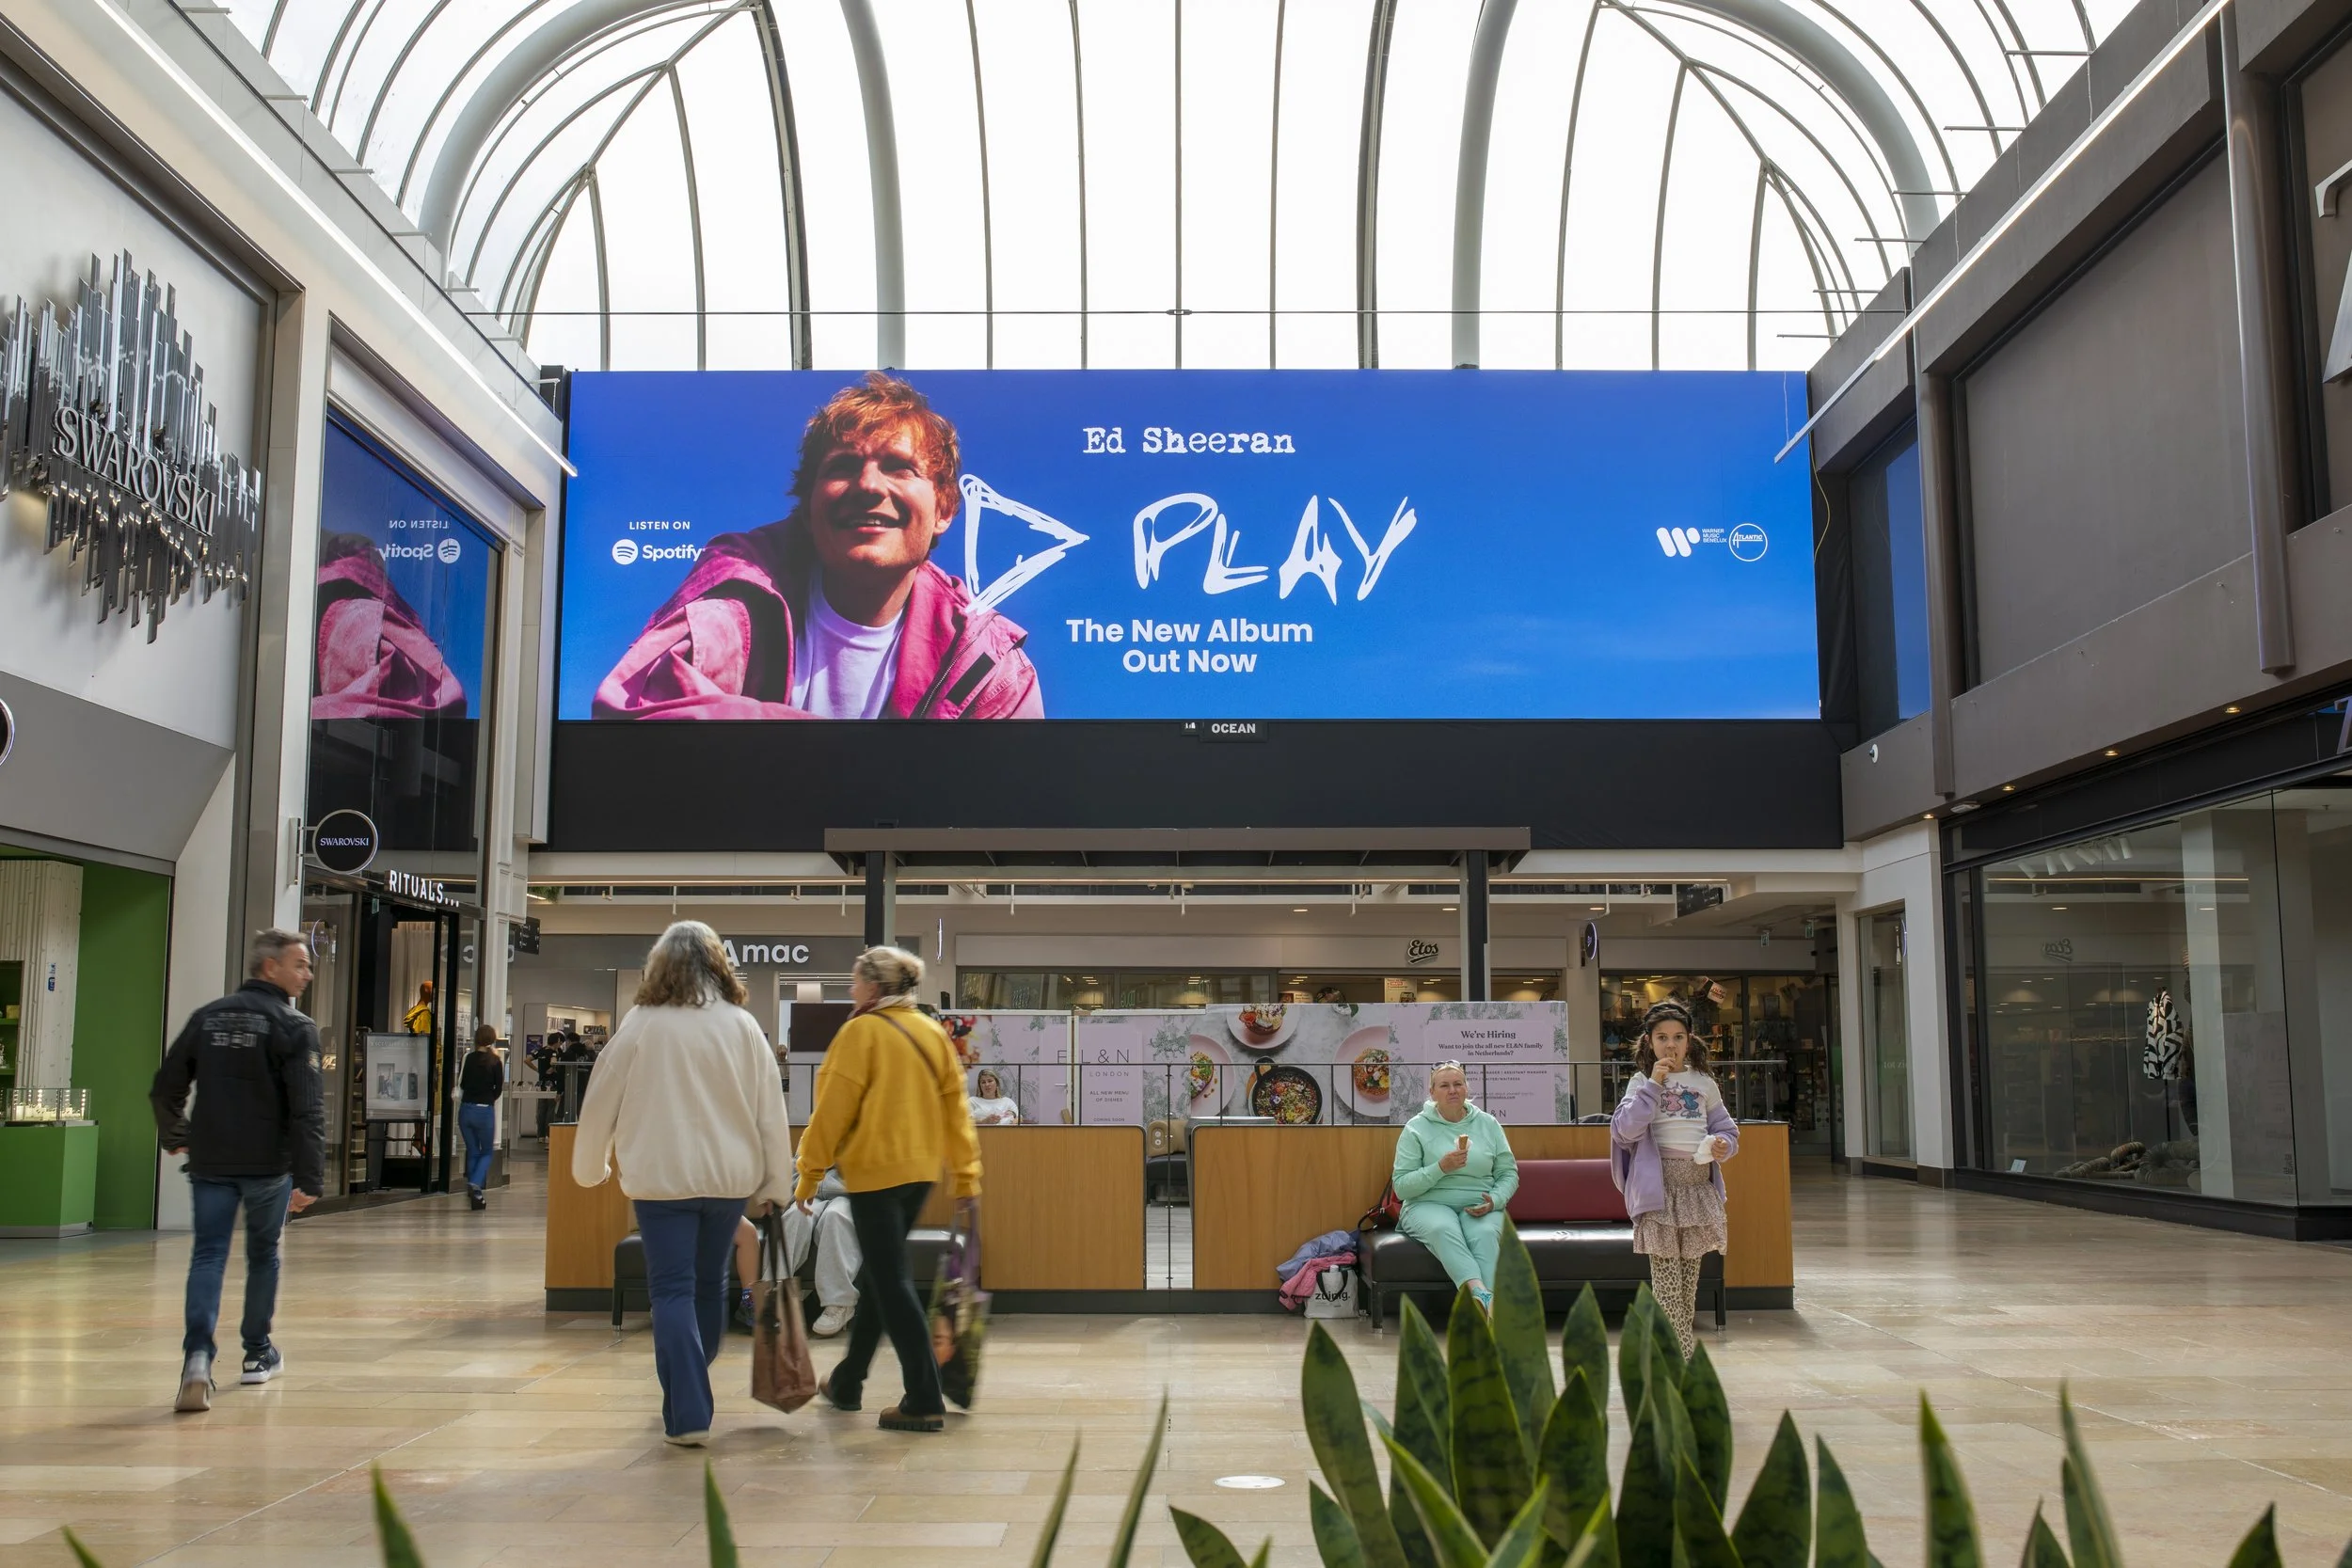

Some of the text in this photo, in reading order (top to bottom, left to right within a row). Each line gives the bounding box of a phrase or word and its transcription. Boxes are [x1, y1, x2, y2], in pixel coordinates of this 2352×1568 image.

[1083, 427, 1295, 453] Ed Sheeran
[53, 406, 217, 537] SWAROVSKI
[628, 521, 691, 531] LISTEN ON
[642, 544, 703, 562] Spotify
[1133, 492, 1418, 606] PLAY
[1066, 619, 1312, 641] The New Album
[1122, 649, 1257, 673] Out Now
[1211, 723, 1256, 734] OCEAN
[320, 837, 369, 847] SWAROVSKI
[1408, 940, 1439, 958] Etos
[1460, 1030, 1517, 1039] We're Hiring
[1462, 1042, 1473, 1051] join
